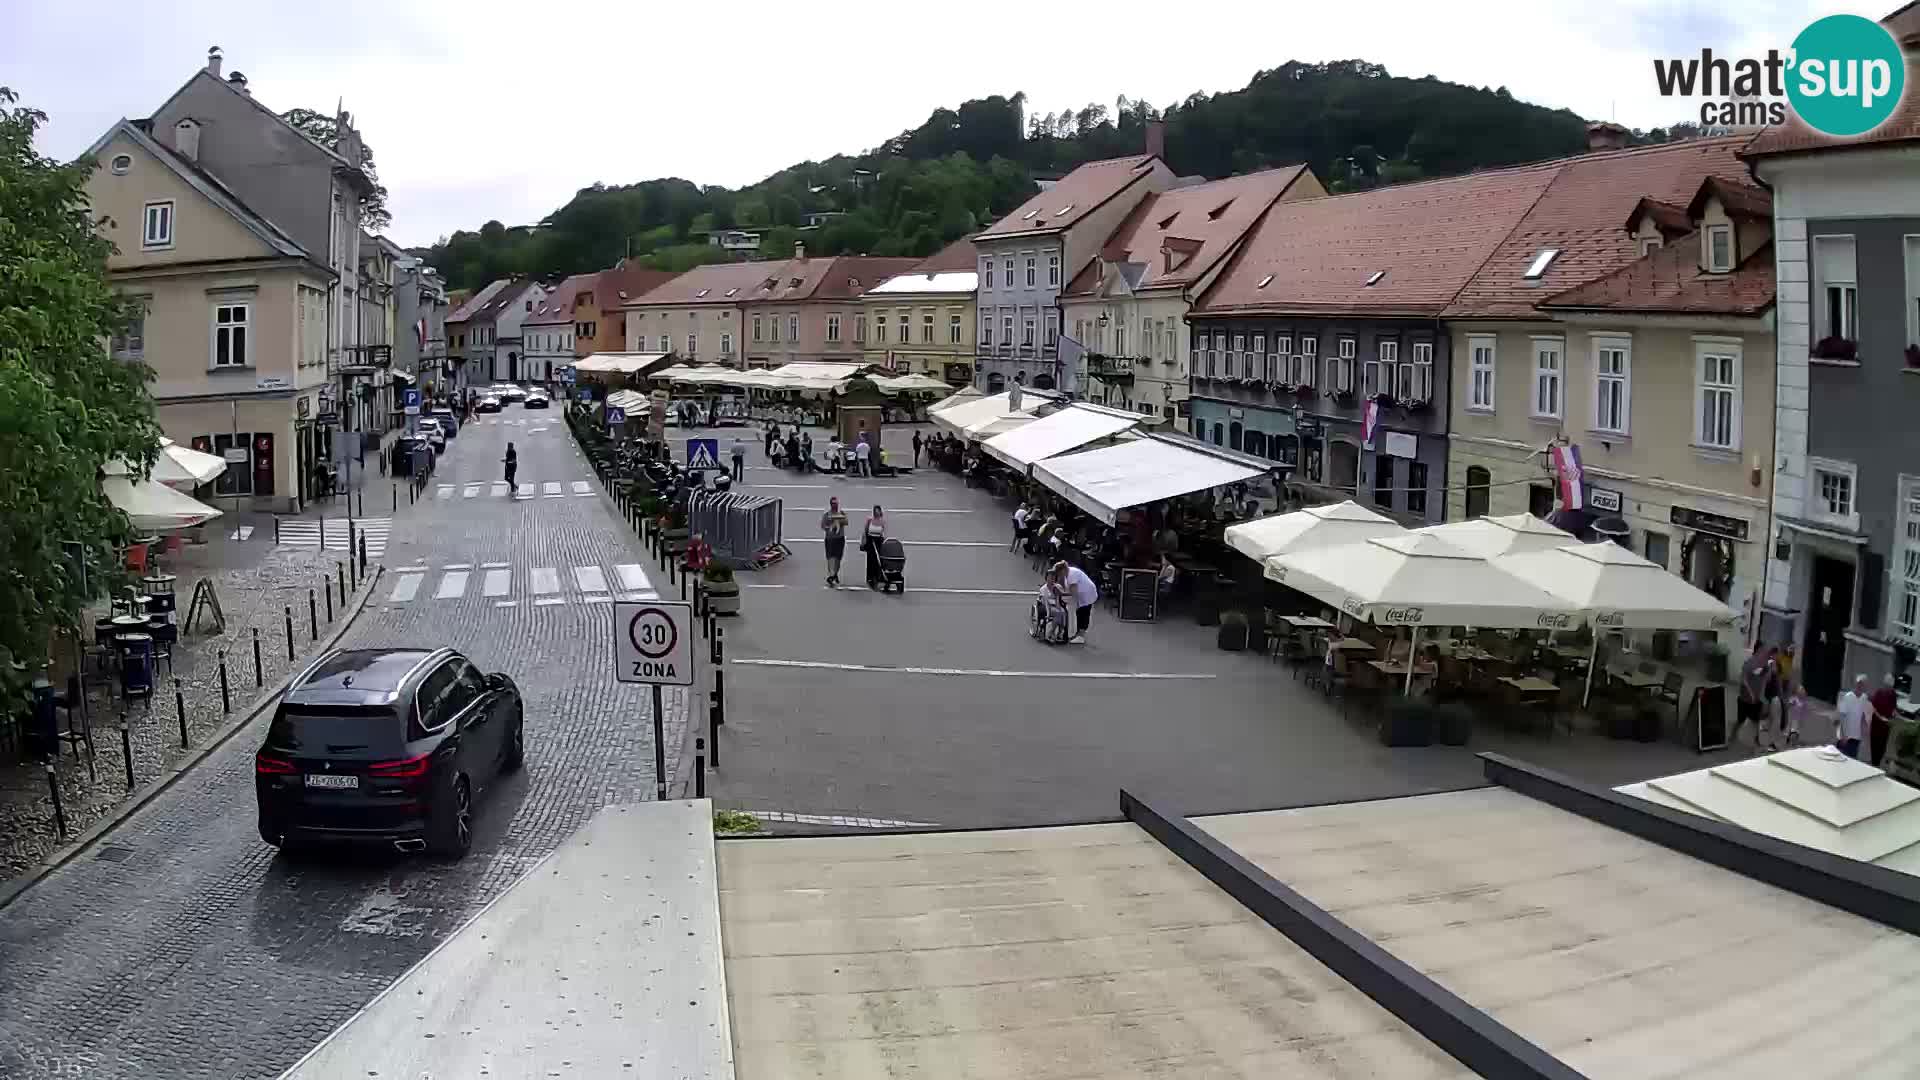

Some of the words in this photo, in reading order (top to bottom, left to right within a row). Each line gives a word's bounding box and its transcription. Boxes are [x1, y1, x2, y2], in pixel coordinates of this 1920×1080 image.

[408, 392, 416, 404] P
[642, 623, 666, 645] 30
[632, 661, 677, 678] ZONA
